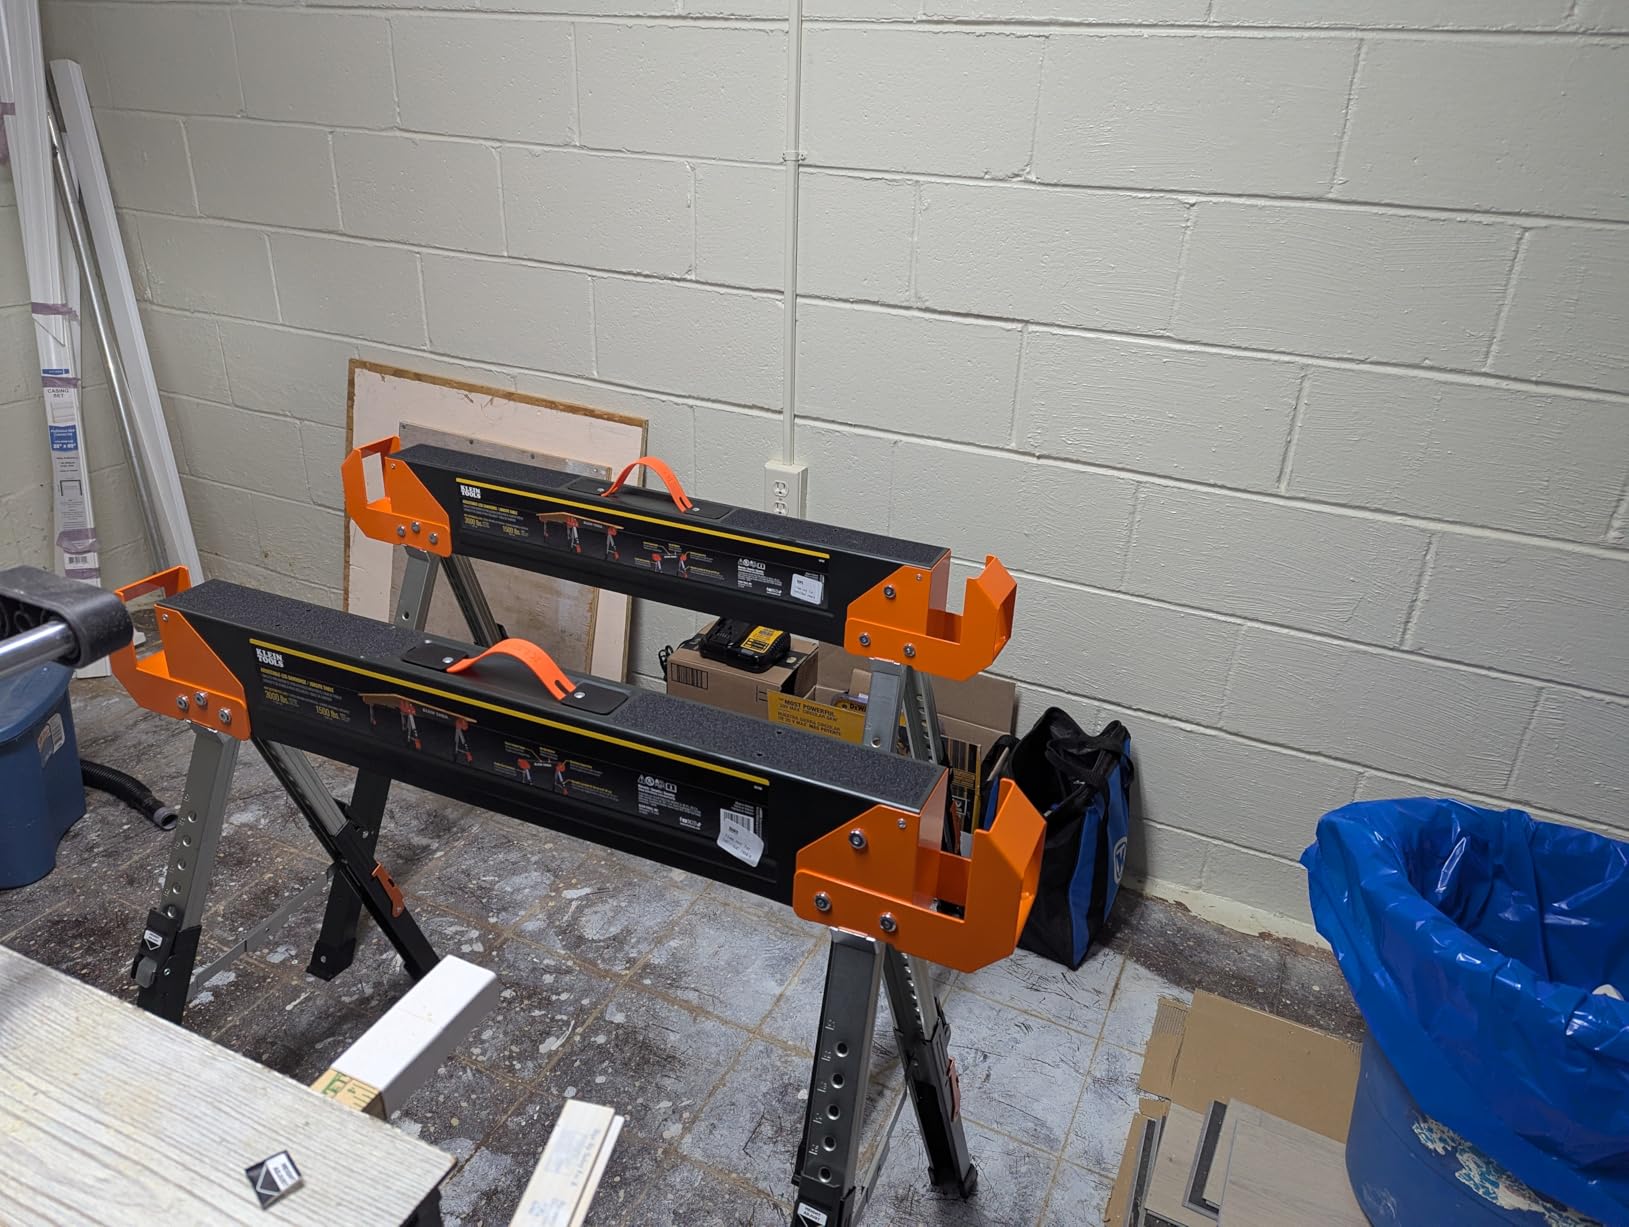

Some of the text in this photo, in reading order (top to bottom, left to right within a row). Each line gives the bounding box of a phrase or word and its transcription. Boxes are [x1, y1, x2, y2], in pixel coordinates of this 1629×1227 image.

[460, 484, 481, 494] KLEIN
[461, 490, 481, 499] TOOLS
[255, 647, 283, 660] KLEIN
[257, 654, 284, 668] TOOLS
[784, 699, 834, 715] MOST POWERFUL
